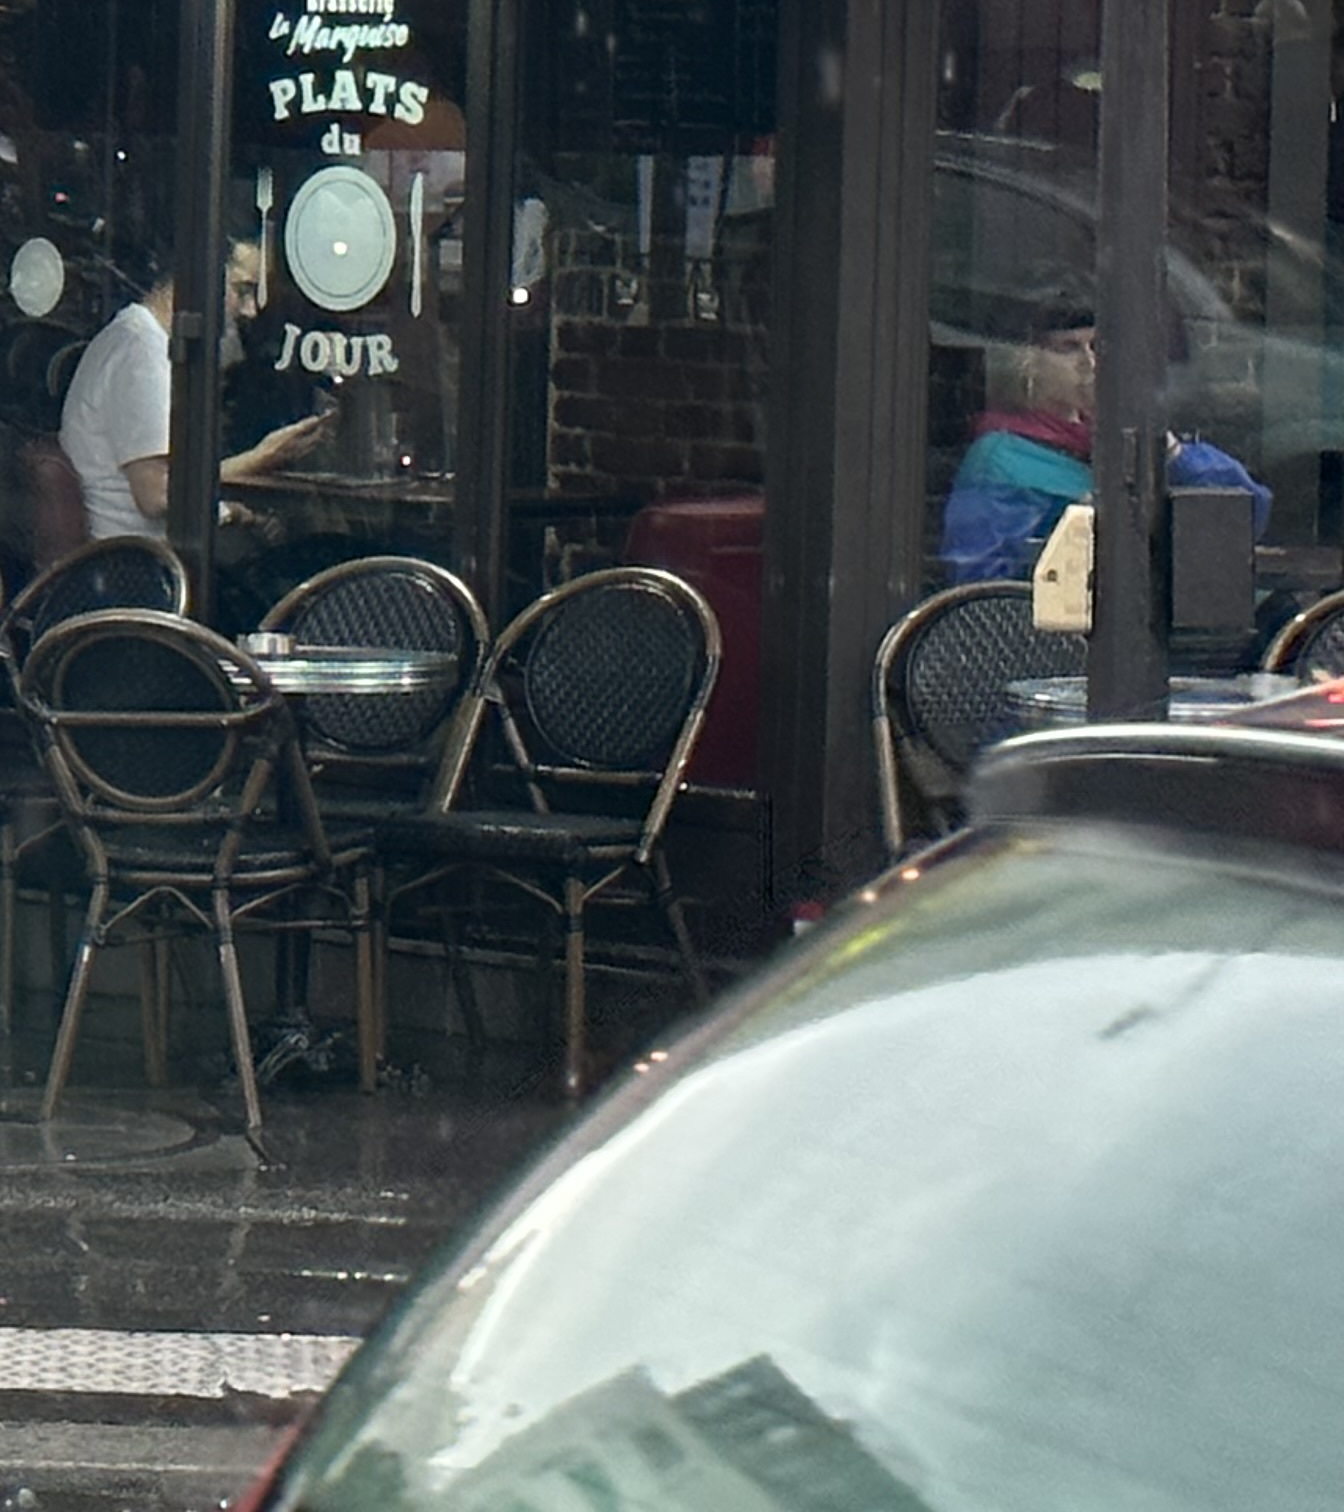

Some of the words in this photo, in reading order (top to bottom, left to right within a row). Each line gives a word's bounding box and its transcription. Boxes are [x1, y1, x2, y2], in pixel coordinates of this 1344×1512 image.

[286, 14, 409, 64] Marquise
[269, 69, 429, 126] PLATS
[320, 122, 362, 157] du
[274, 322, 400, 378] JOUR
